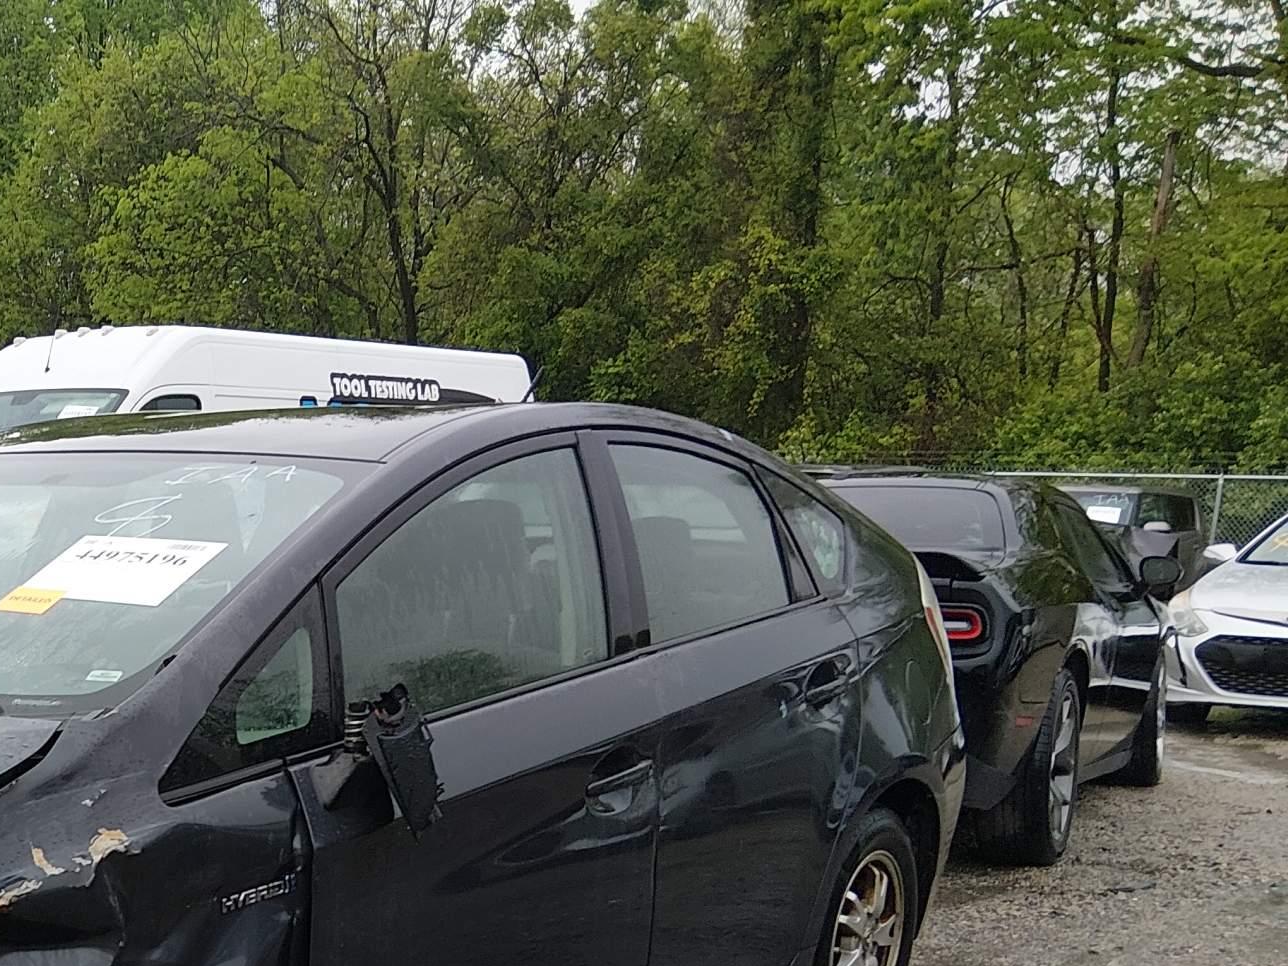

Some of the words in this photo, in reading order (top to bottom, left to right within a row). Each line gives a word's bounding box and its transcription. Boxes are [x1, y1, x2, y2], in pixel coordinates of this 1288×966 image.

[332, 377, 368, 398] TOOL
[368, 379, 416, 400] TESTING
[416, 382, 440, 401] LAB
[164, 465, 297, 485] IAA
[75, 549, 188, 567] 44975196
